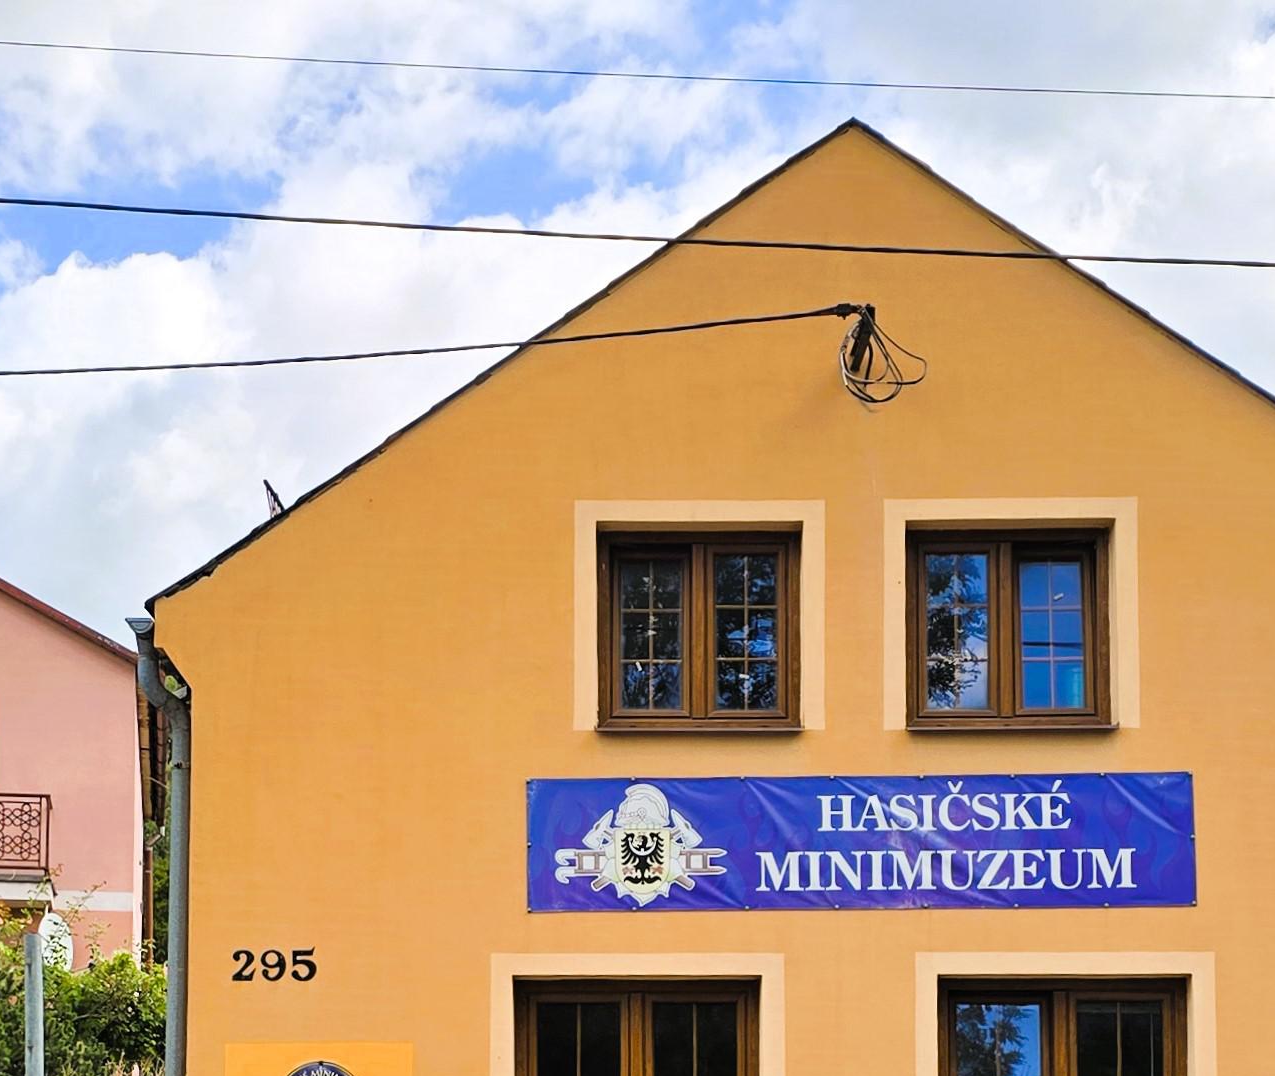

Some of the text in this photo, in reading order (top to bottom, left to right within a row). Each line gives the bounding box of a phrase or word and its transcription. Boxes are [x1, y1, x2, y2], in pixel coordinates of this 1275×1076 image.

[816, 779, 1072, 832] HASIČSKÉ
[755, 847, 1137, 892] MINIMUZEUM
[231, 946, 318, 982] 295
